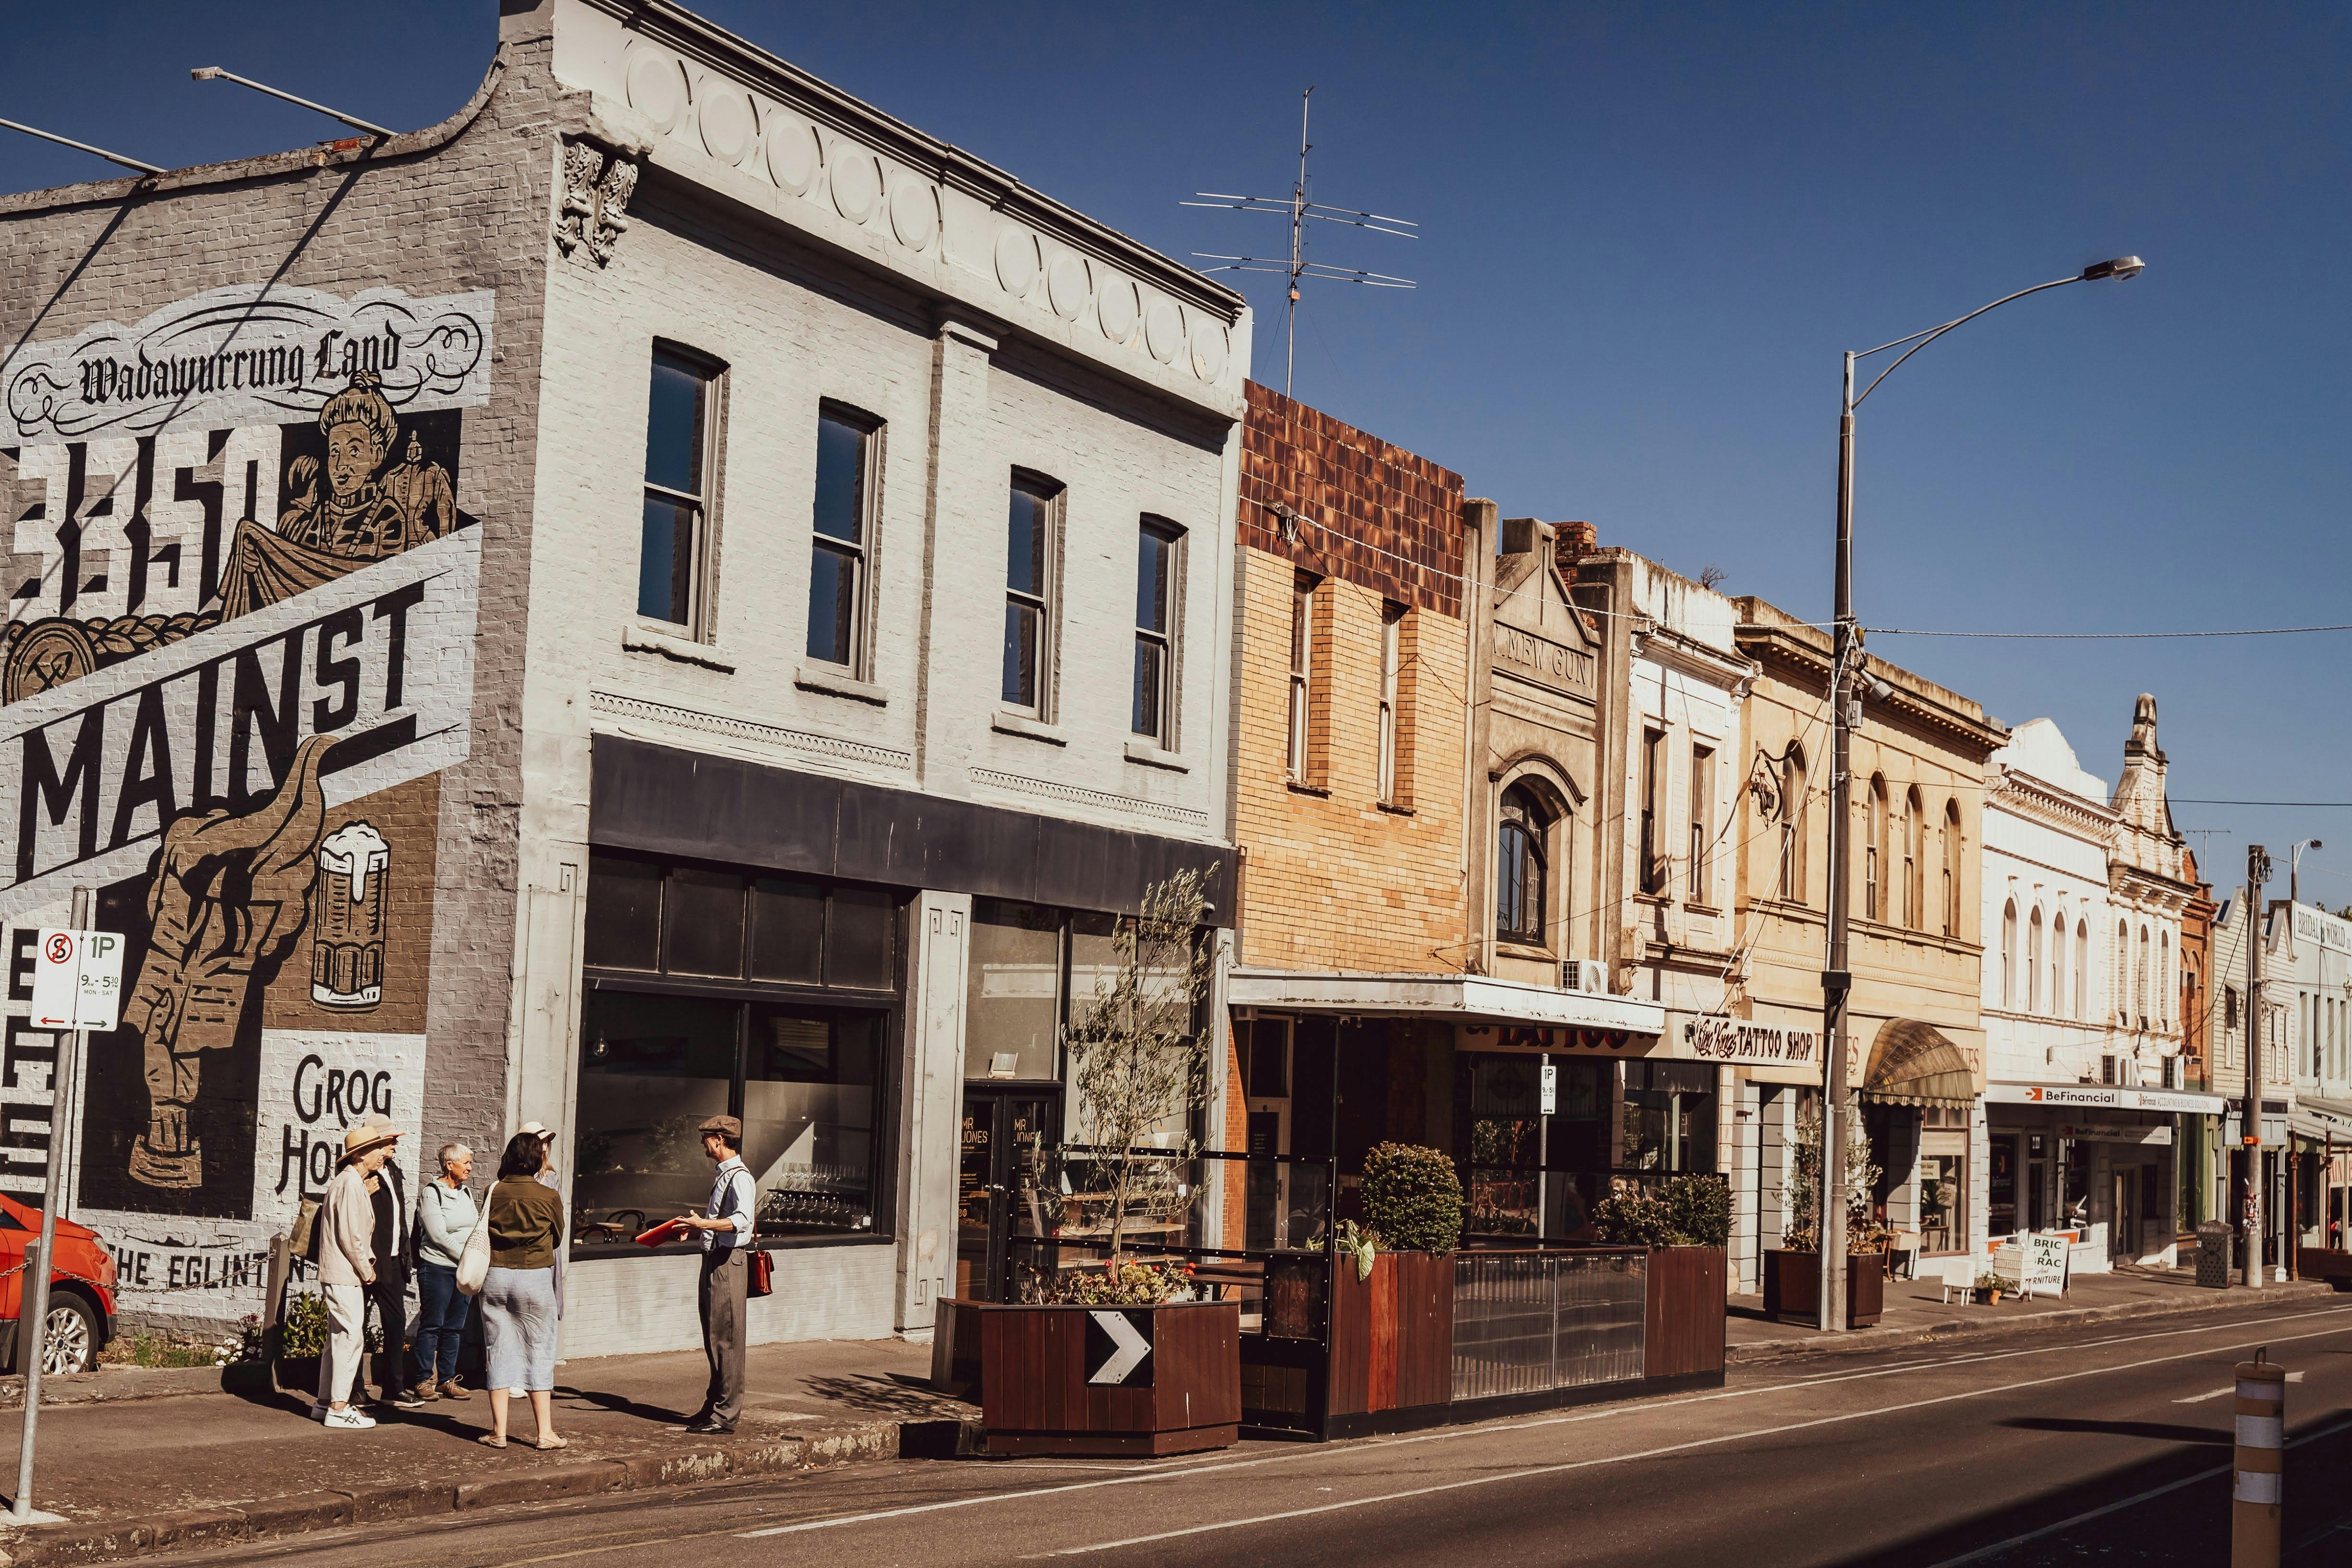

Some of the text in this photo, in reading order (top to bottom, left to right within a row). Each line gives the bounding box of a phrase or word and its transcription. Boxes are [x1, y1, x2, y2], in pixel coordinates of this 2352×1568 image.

[78, 319, 401, 405] Wadawurrung Land
[1552, 647, 1585, 685] GUN
[16, 589, 425, 886] MAIN ST
[2298, 911, 2319, 940] BRIDAL
[2326, 922, 2345, 948] WORLD
[92, 936, 115, 958] 1P
[1737, 1026, 1781, 1058] TATTOO
[1786, 1031, 1812, 1061] SHOP
[1544, 1069, 1553, 1079] 1P
[293, 1054, 391, 1129] GROG
[2046, 1091, 2114, 1103] BeFinancial
[962, 1117, 974, 1130] MR
[1014, 1119, 1026, 1131] MR
[961, 1131, 988, 1144] JONES
[1016, 1132, 1035, 1143] JONE
[2034, 1239, 2062, 1249] BRIC
[2035, 1257, 2061, 1267] RAC
[169, 1252, 304, 1290] EGLINTN
